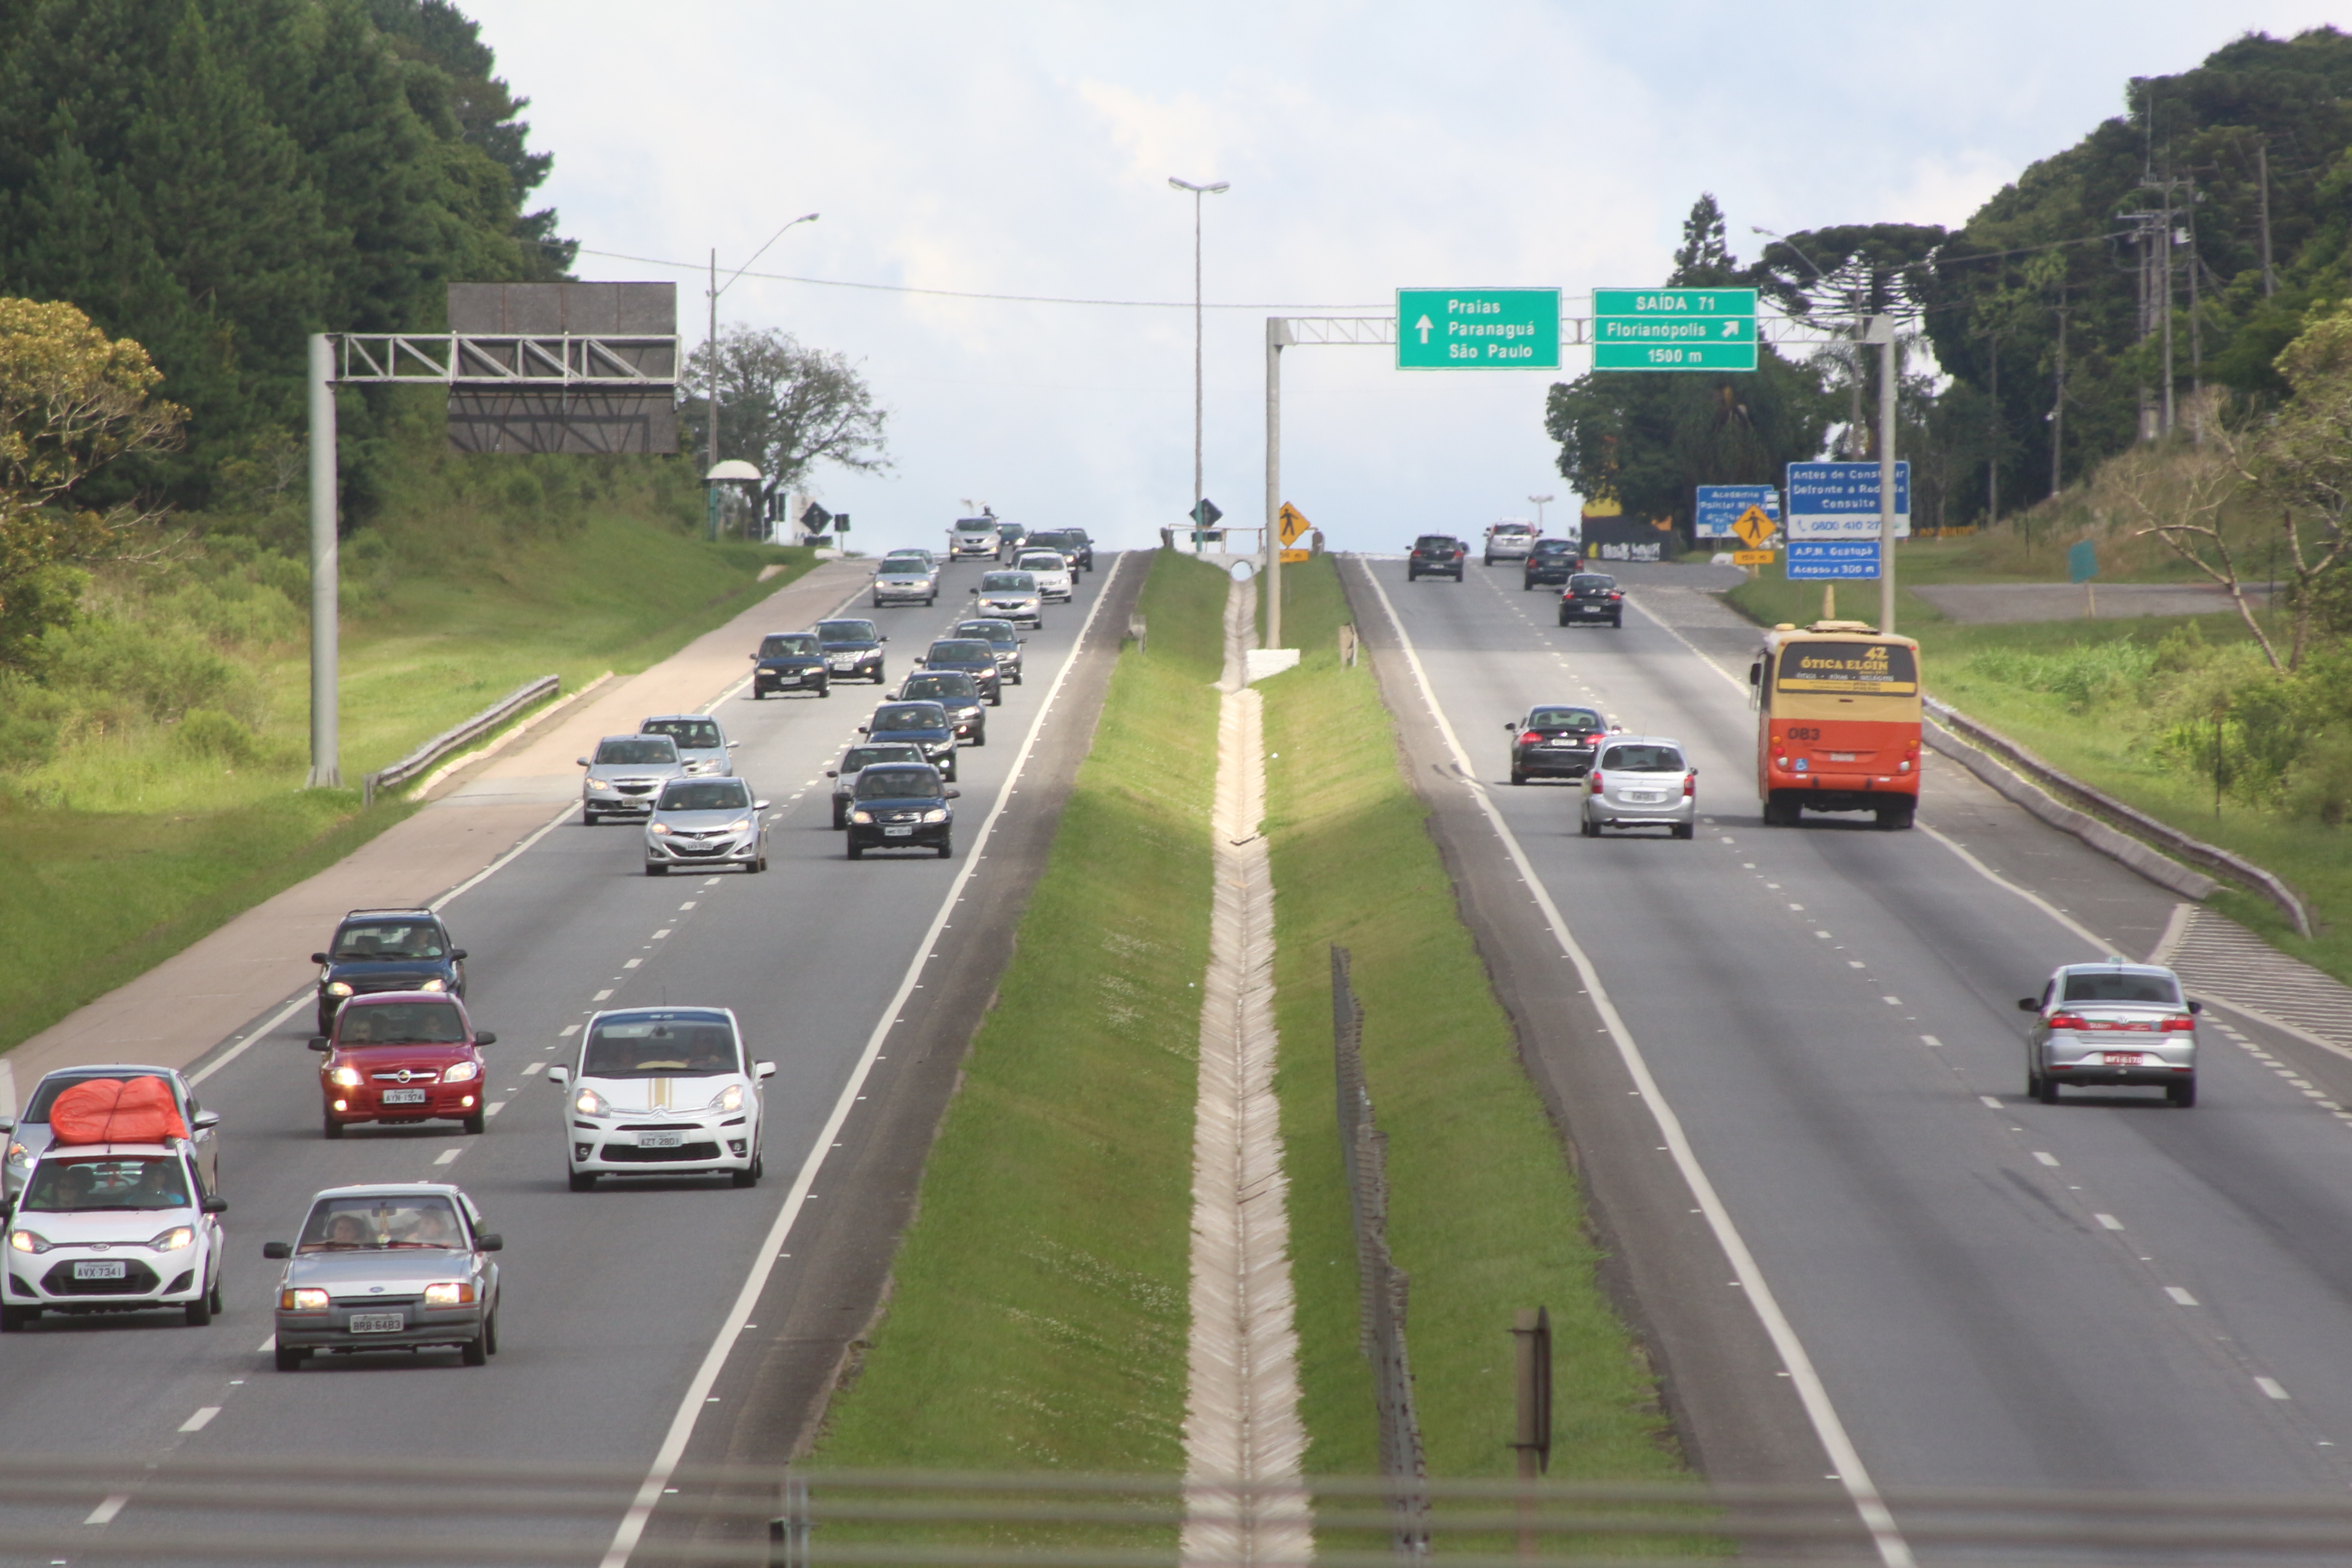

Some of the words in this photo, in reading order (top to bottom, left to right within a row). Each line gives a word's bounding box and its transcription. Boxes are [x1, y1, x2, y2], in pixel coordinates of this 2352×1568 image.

[1448, 299, 1501, 314] Praias
[1636, 293, 1688, 311] SAÍDA
[1698, 296, 1715, 311] 71
[1448, 320, 1535, 339] Paranaguá
[1607, 322, 1706, 339] Florianópolis
[1449, 343, 1478, 358] São
[1488, 343, 1533, 358] Paulo
[1648, 348, 1683, 363] 1500
[1688, 351, 1702, 363] m
[1793, 470, 1826, 480] Antes
[1831, 470, 1844, 479] de
[1793, 484, 1843, 495] Defronte
[1822, 499, 1876, 508] Consulte
[1811, 521, 1839, 530] 0800
[1843, 521, 1862, 530] 410
[1865, 647, 1890, 660] 42
[1800, 656, 1843, 669] ÓTICA
[1788, 728, 1821, 740] 083
